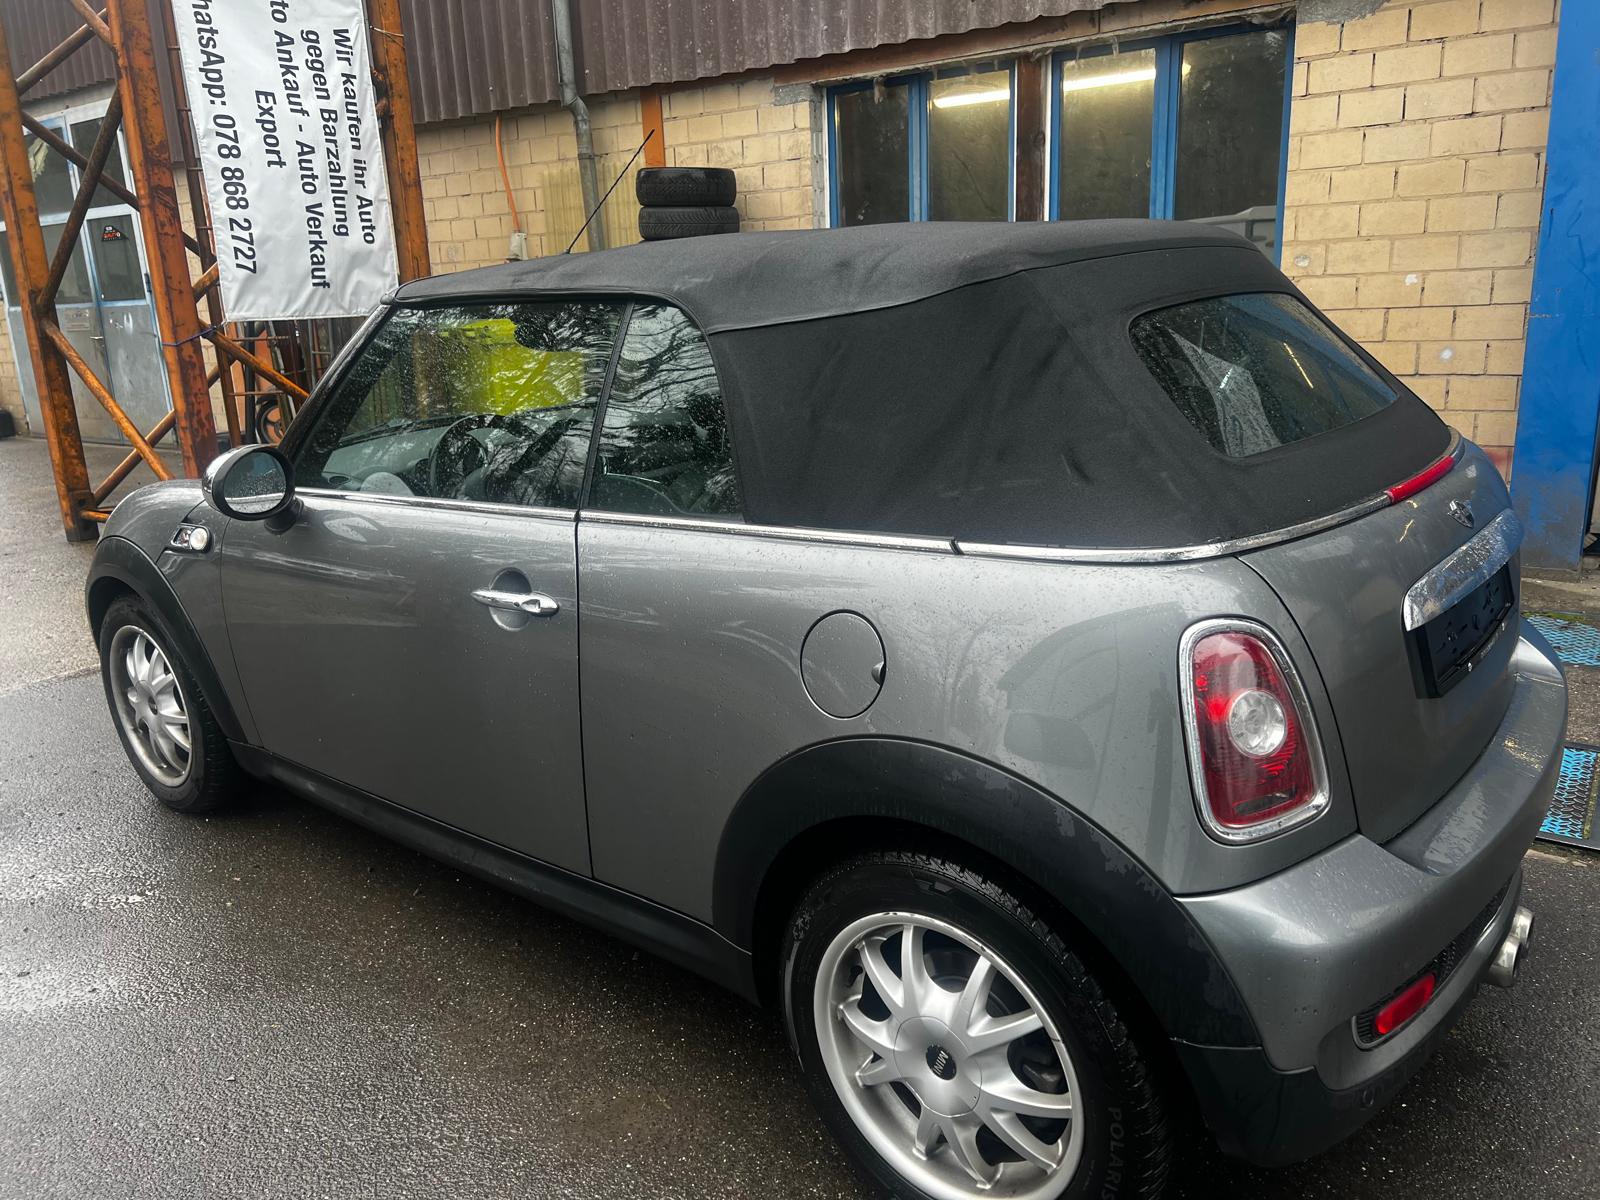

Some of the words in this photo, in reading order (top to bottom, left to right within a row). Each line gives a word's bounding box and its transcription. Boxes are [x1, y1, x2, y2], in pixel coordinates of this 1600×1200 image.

[274, 30, 309, 116] Ankauf
[333, 29, 353, 66] Wir
[213, 115, 241, 158] 078
[255, 91, 286, 168] Export
[301, 30, 330, 100] gegen
[320, 109, 349, 236] Barzahlung
[341, 73, 361, 150] kaufen
[221, 167, 249, 209] 868
[296, 140, 318, 194] Auto
[353, 159, 367, 188] ihr
[229, 218, 256, 274] 2727
[306, 203, 330, 288] Verkauf
[356, 195, 376, 244] Auto
[932, 1050, 949, 1076] MINI
